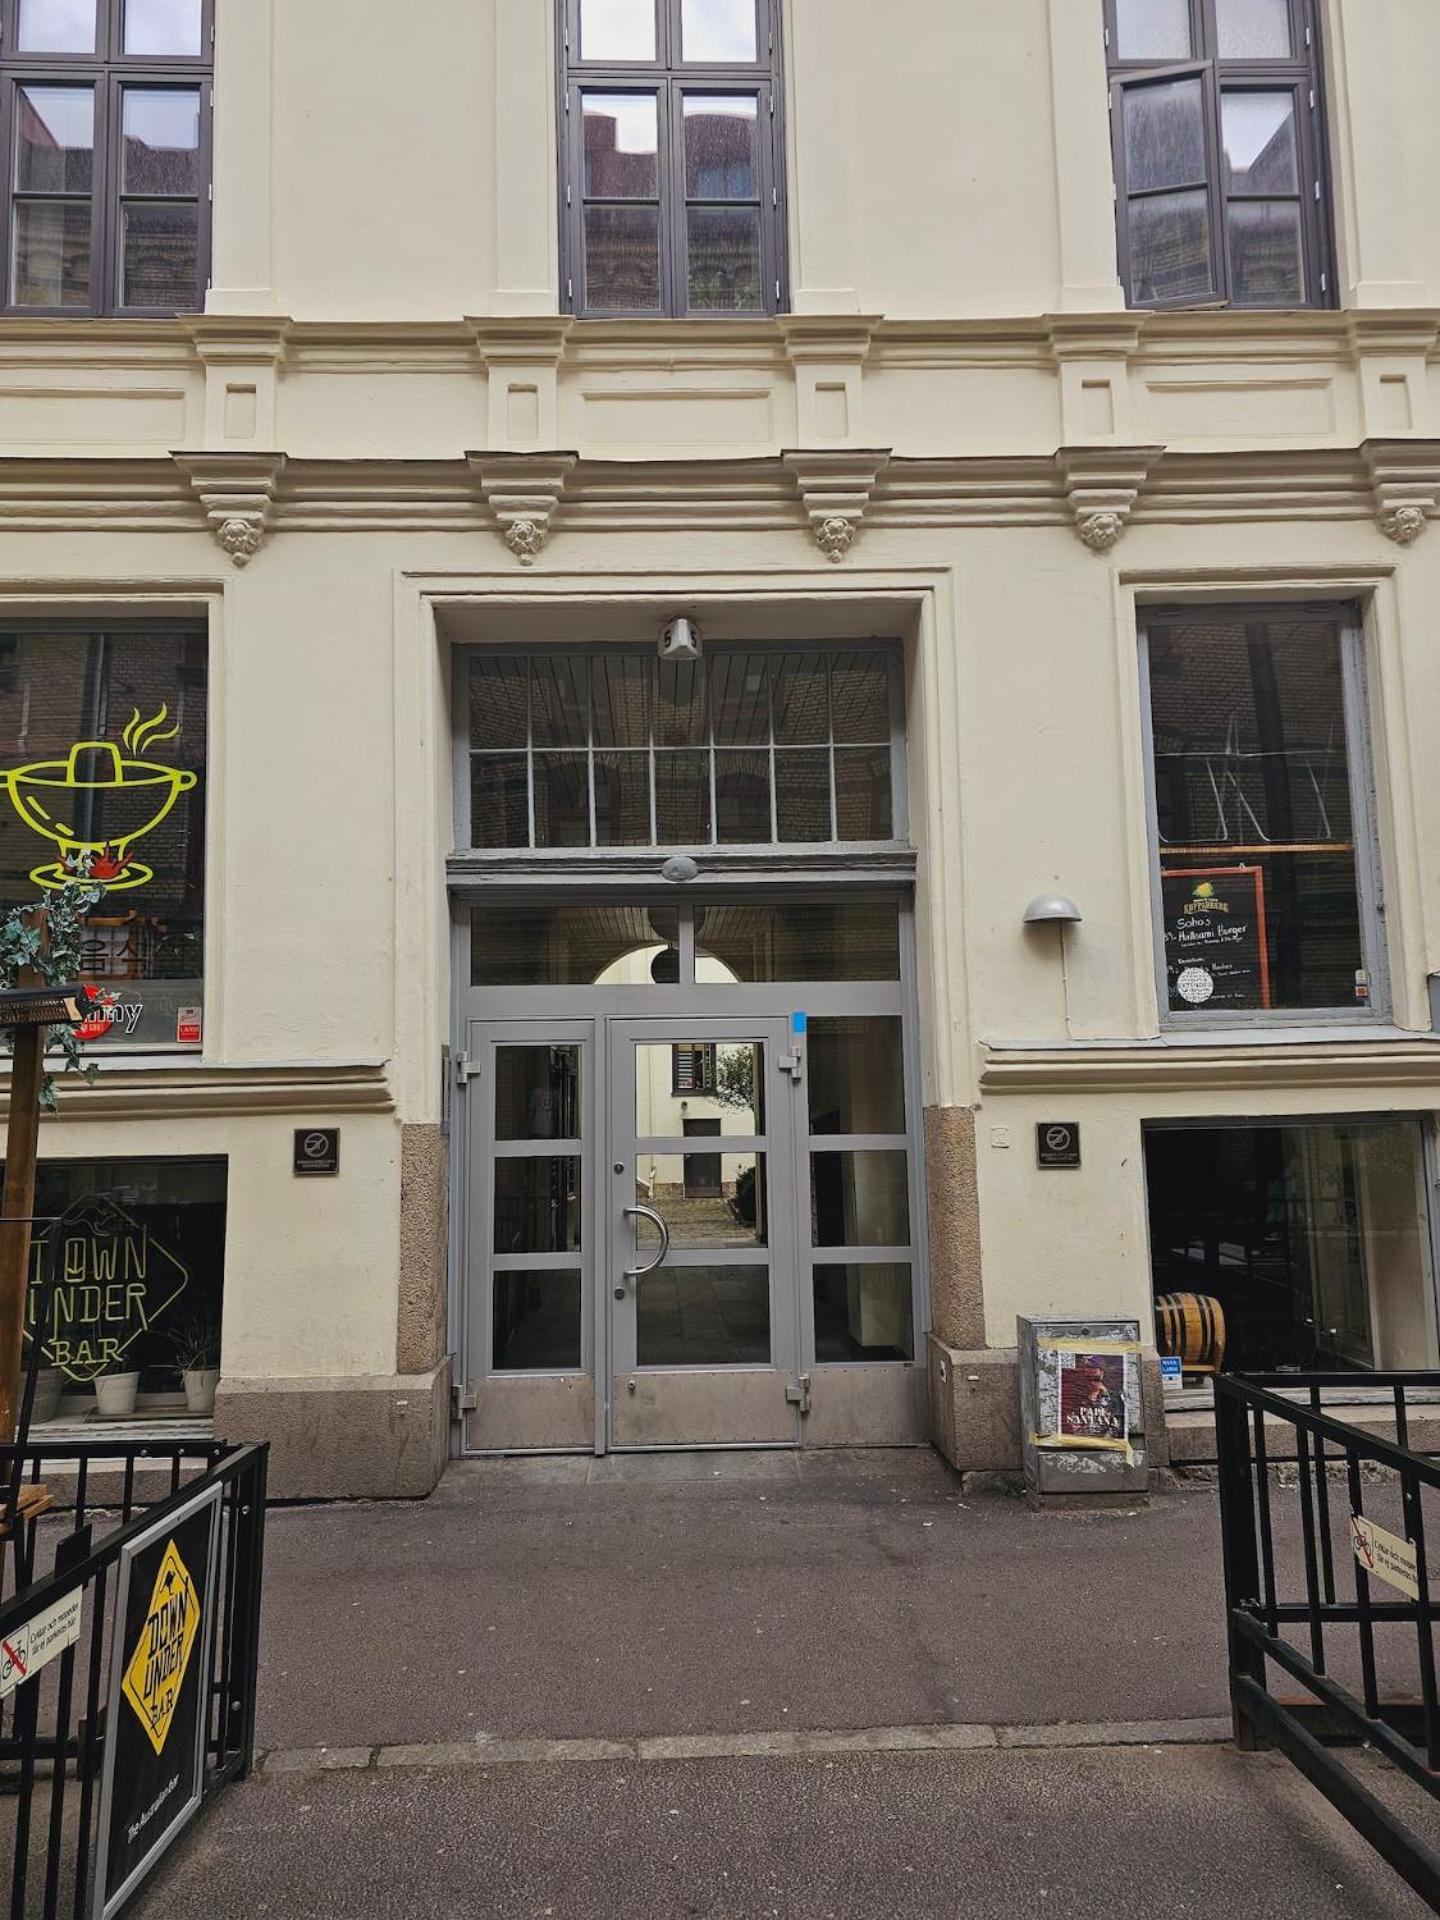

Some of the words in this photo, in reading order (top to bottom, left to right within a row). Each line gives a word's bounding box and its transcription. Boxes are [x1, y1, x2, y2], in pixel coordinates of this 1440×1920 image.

[663, 630, 672, 648] 5
[690, 630, 697, 648] 5
[1217, 924, 1248, 938] Burger
[51, 1338, 123, 1366] BAR
[148, 1576, 188, 1660] DOWN
[144, 1631, 184, 1712] UNDER
[150, 1687, 174, 1731] BAR
